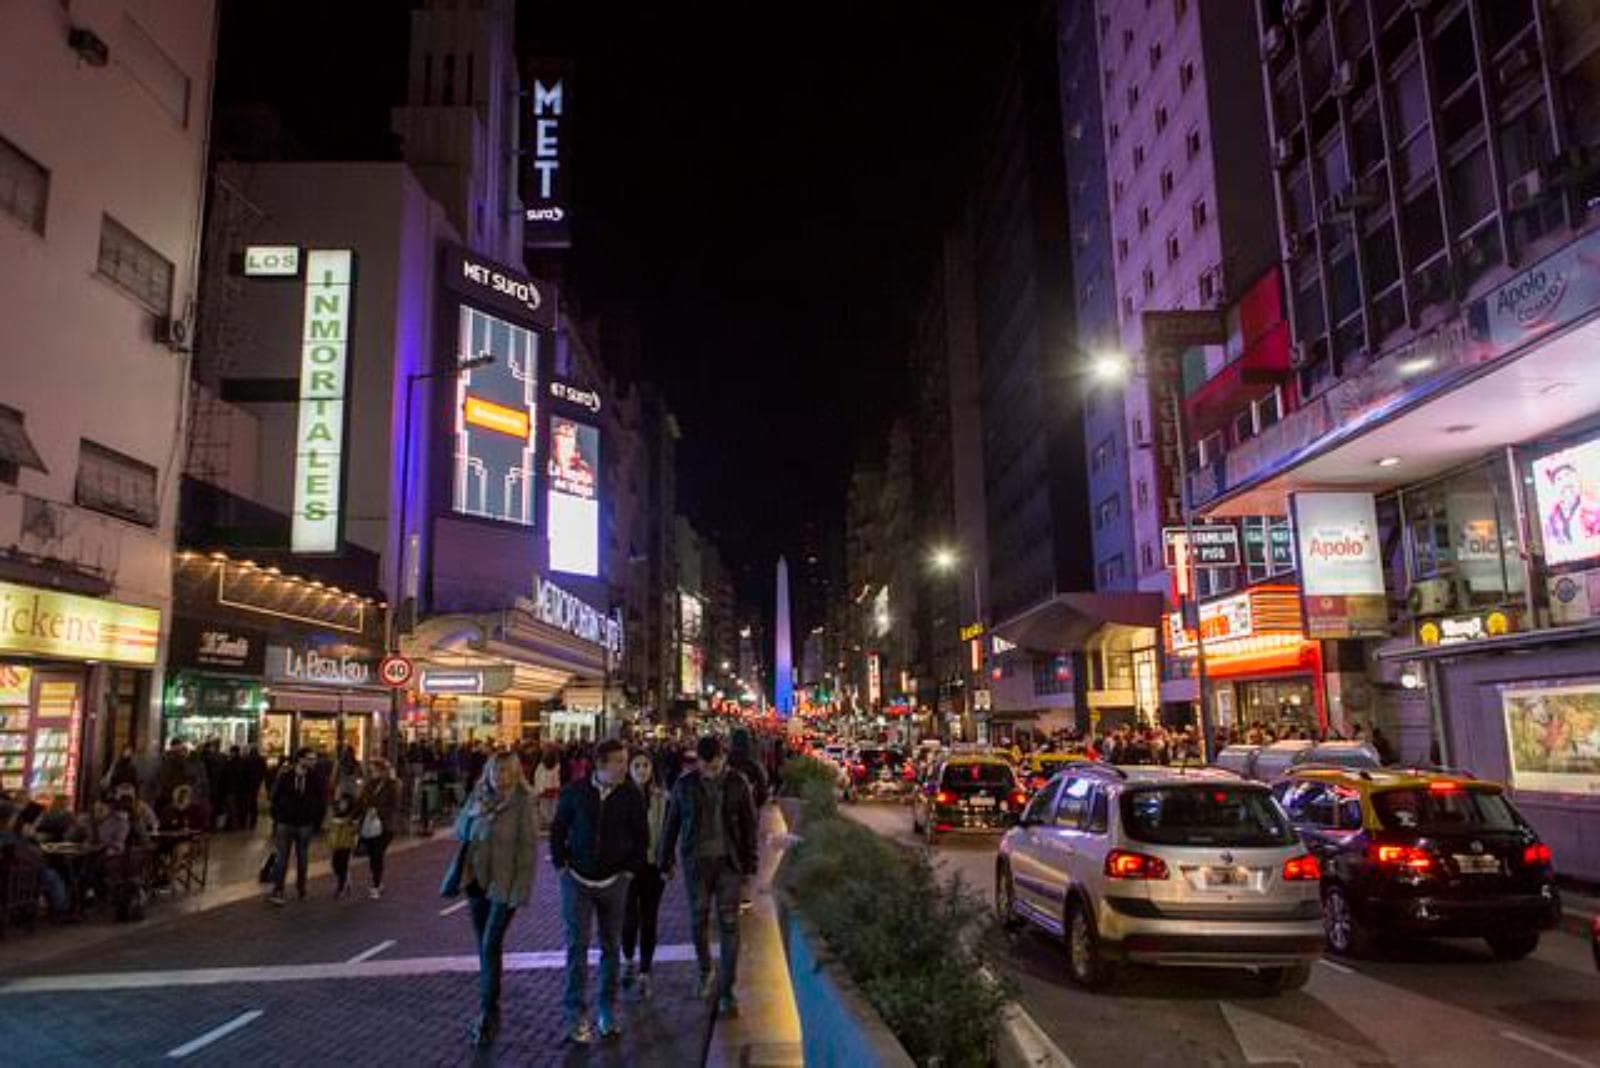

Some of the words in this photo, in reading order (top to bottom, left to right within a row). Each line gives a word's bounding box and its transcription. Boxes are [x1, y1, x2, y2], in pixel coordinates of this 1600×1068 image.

[534, 79, 563, 199] MET
[248, 254, 297, 268] LOS
[302, 269, 341, 523] INMORTALES
[1310, 536, 1363, 561] Apolo
[0, 594, 98, 642] ickens
[387, 664, 406, 678] 40
